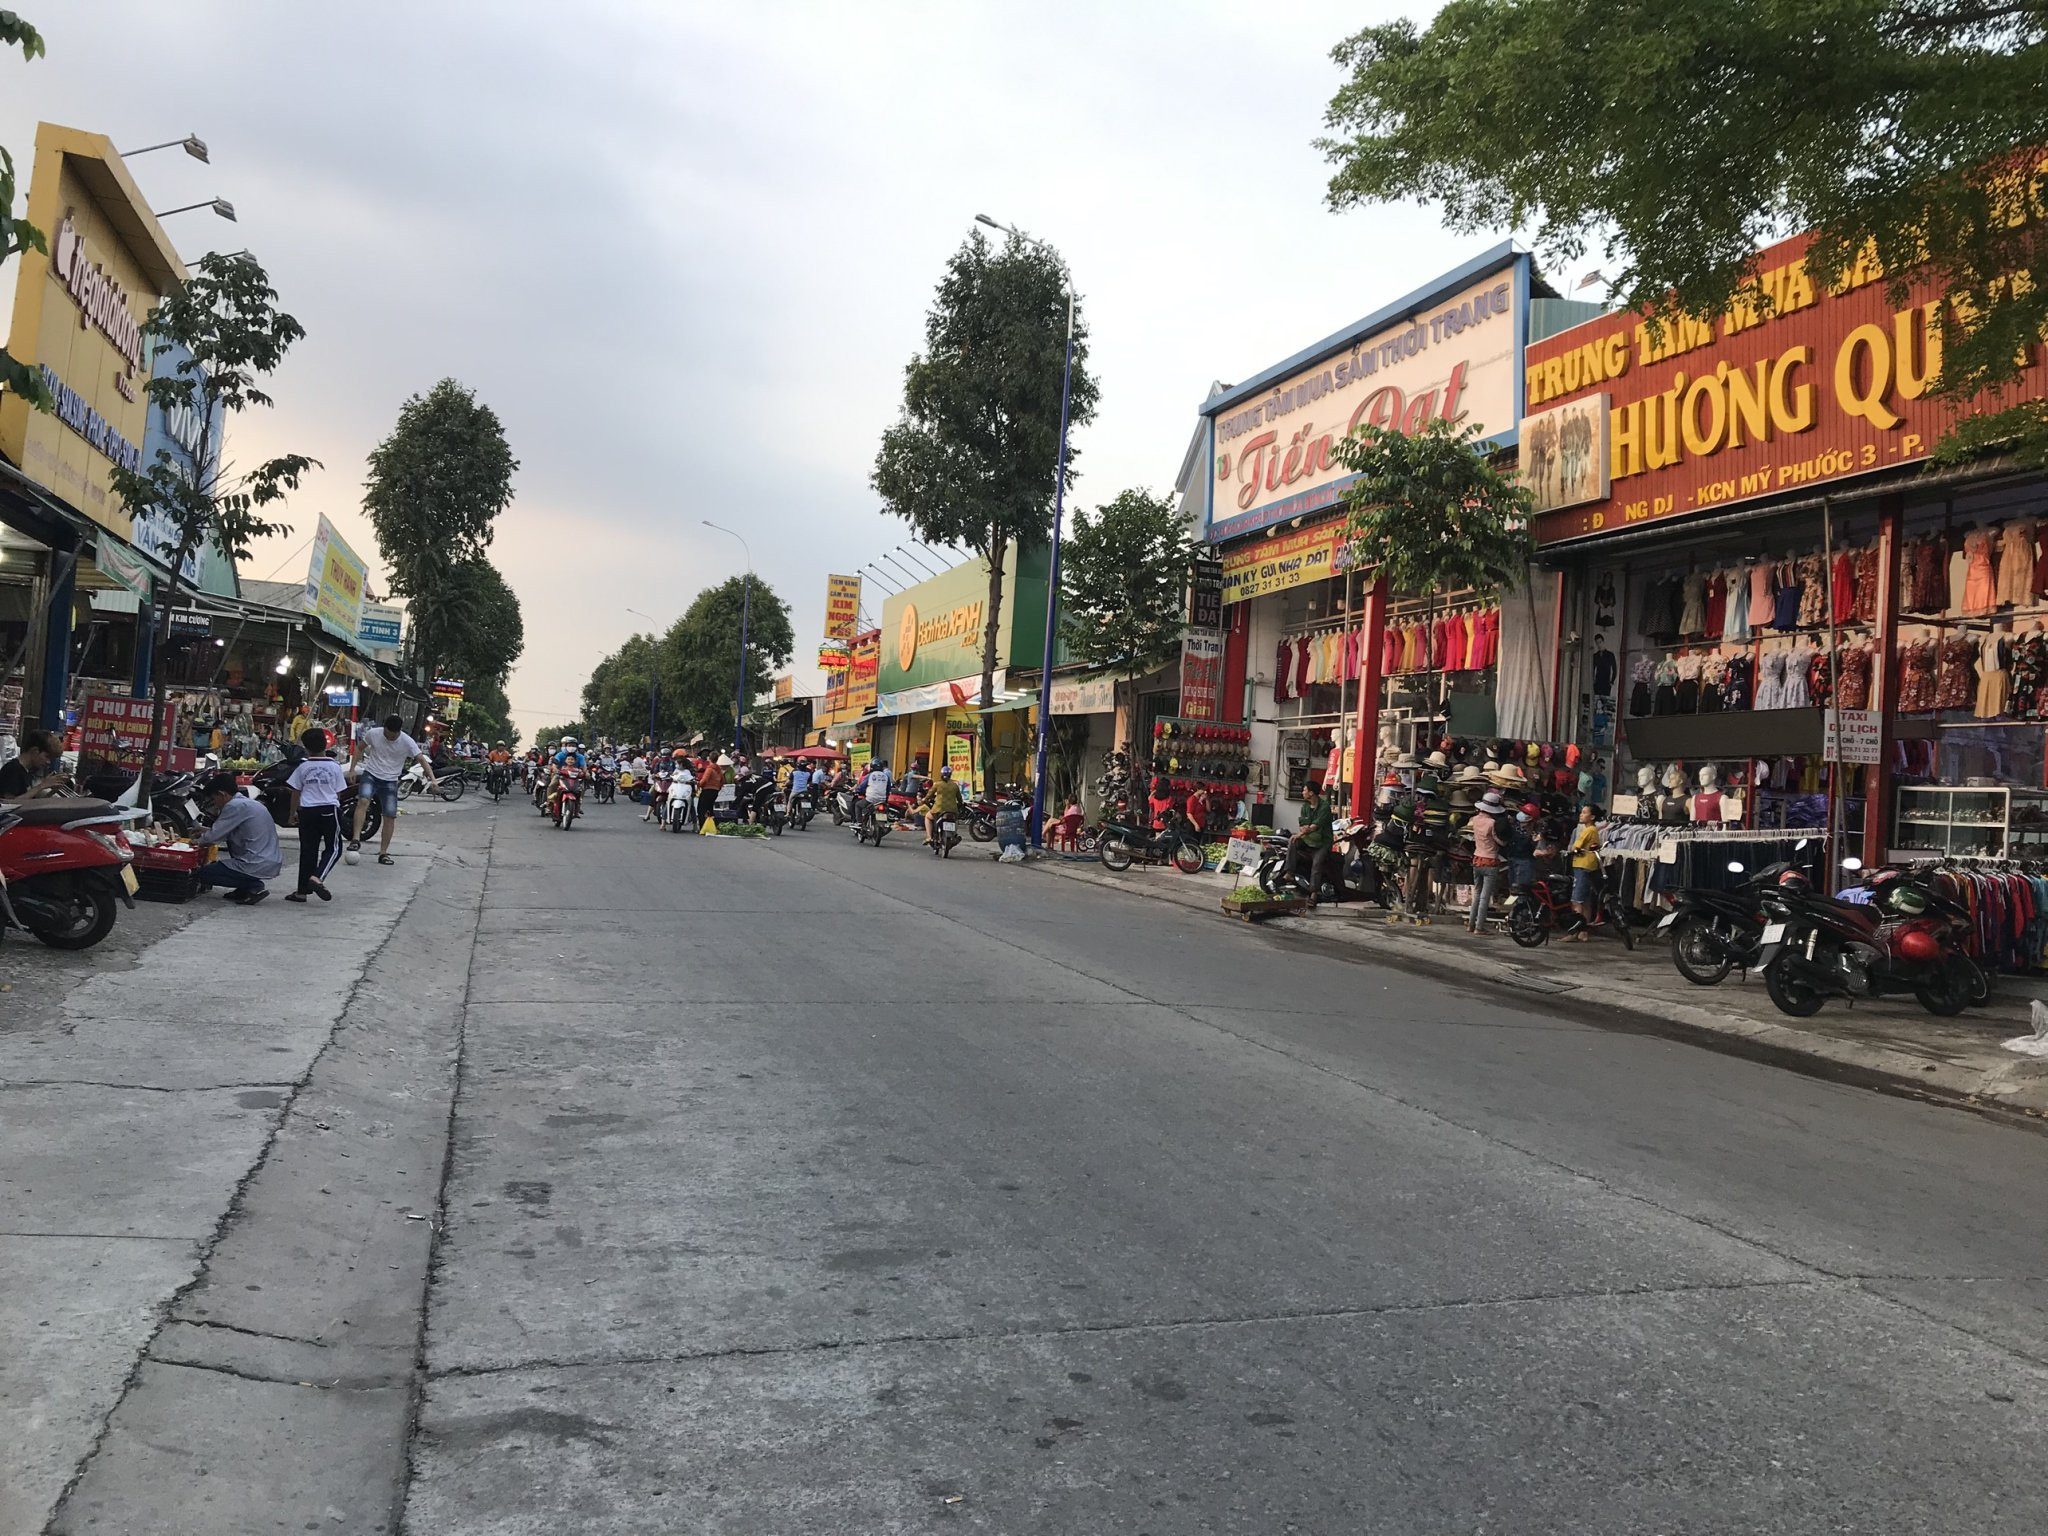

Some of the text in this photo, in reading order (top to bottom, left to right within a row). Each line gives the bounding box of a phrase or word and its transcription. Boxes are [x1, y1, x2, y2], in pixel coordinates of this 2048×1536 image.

[1526, 331, 1627, 406] TRUNG
[1723, 258, 1817, 336] MUA
[1217, 282, 1511, 445] TRUNG TÂM MUA SẮM THỜI TRANG
[1609, 346, 1813, 481] HƯƠNG
[1237, 422, 1340, 510] Tiến
[1697, 479, 1737, 506] KCN
[1740, 463, 1773, 496] MỸ
[1778, 447, 1854, 487] PHƯỚC
[1860, 443, 1877, 466] 3
[1282, 534, 1309, 553] MUA
[1305, 544, 1330, 567] ĐẤT
[1240, 573, 1300, 597] 0827 31 31 33
[832, 599, 853, 610] KIM
[92, 699, 126, 719] PHỤ
[1840, 712, 1868, 722] TAXI
[1850, 724, 1878, 735] LỊCH
